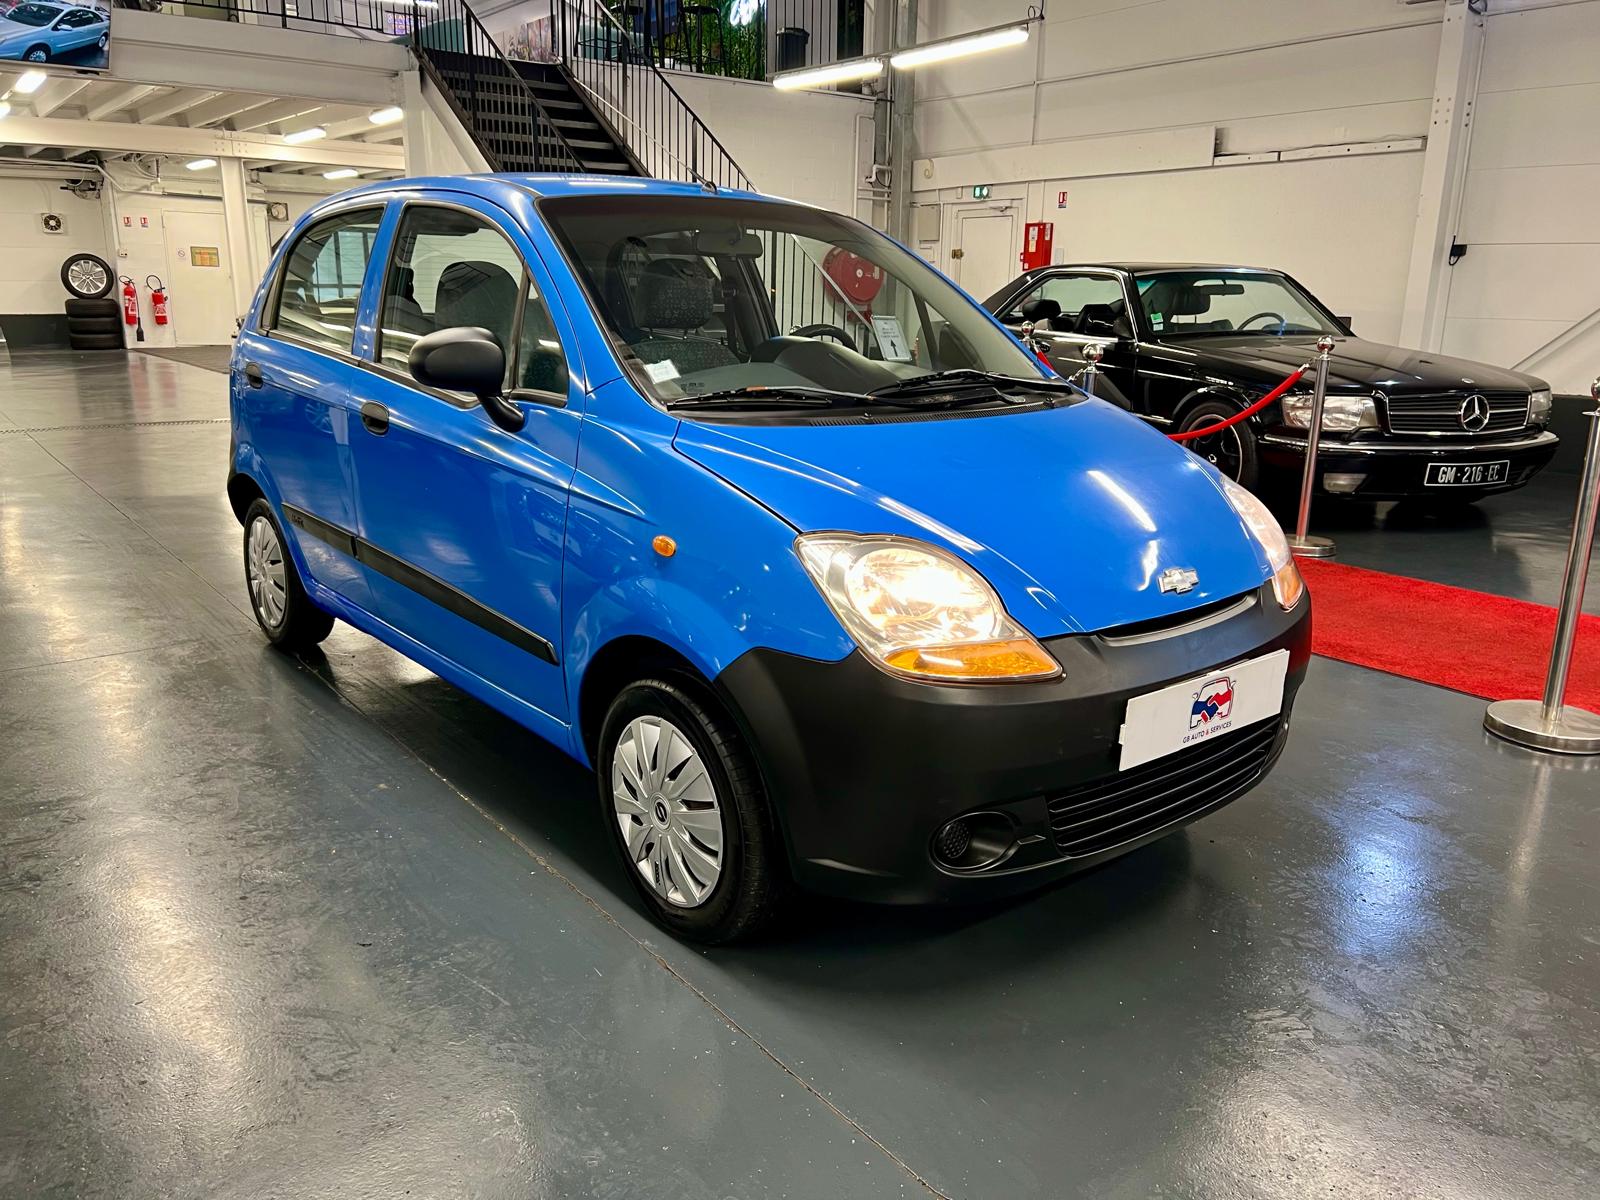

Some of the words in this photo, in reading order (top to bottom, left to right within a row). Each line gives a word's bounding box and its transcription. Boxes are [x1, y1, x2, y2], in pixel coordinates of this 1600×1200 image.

[1182, 735, 1190, 743] GB
[1190, 730, 1204, 740] AUTO
[1210, 721, 1231, 733] SERVICES
